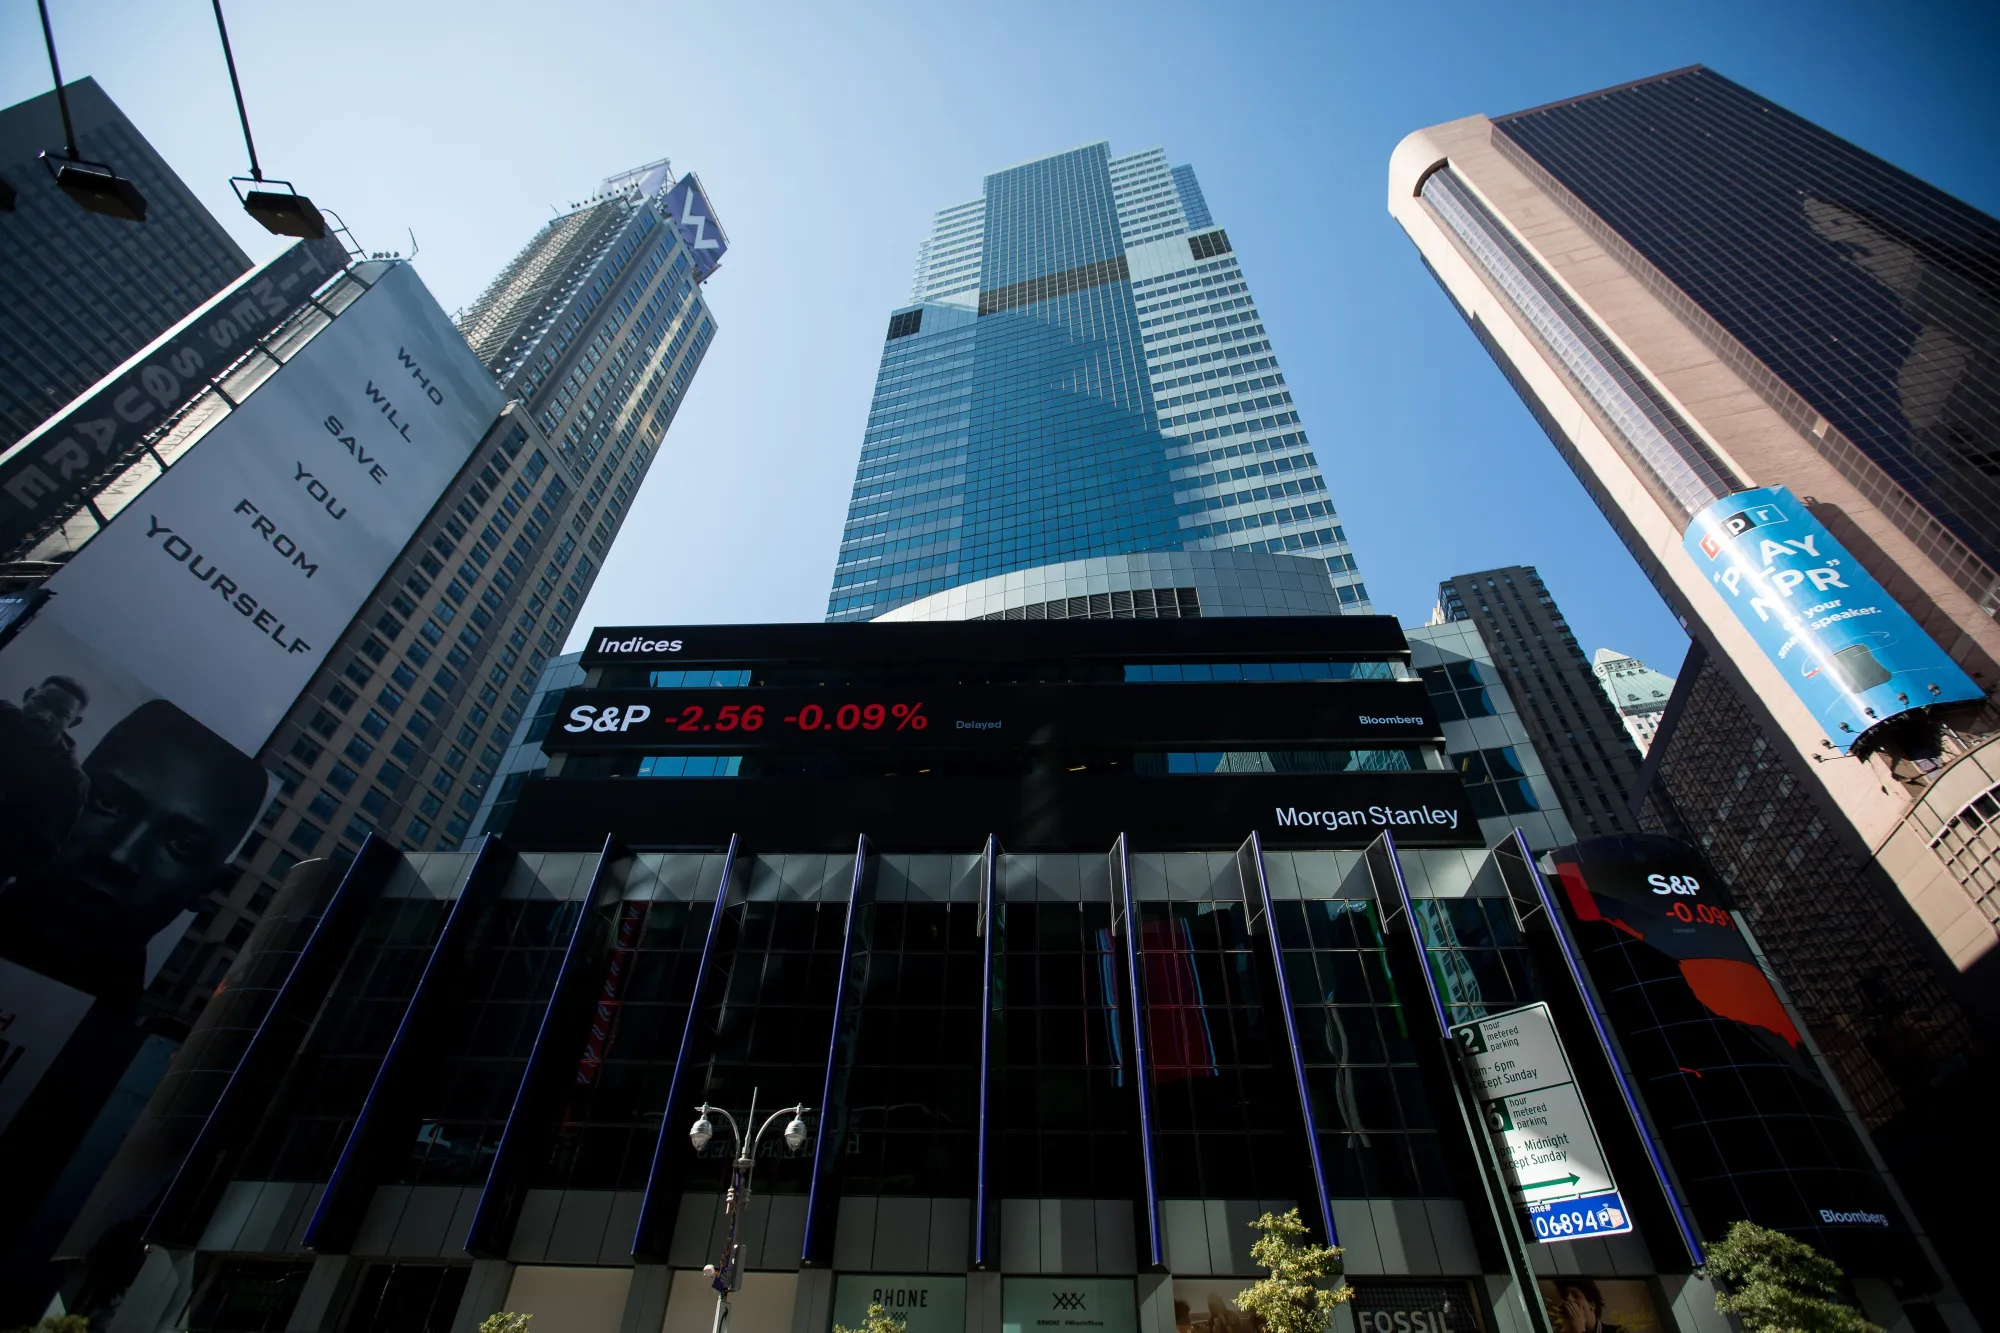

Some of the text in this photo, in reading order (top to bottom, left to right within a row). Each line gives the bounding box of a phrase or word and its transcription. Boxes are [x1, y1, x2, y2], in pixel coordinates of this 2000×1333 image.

[397, 346, 444, 406] WHO
[365, 380, 412, 443] WILL
[323, 415, 388, 485] SAVE
[294, 461, 348, 520] YOU
[233, 498, 319, 579] FROM
[146, 514, 312, 654] YOURSELF
[1803, 599, 1842, 619] your
[1810, 605, 1882, 631] speaker.
[598, 636, 683, 653] Indices
[563, 702, 928, 733] S&P -2.56 -0.09%
[956, 719, 1002, 730] Delayed
[1358, 714, 1424, 726] Bloomberg
[1275, 805, 1458, 831] Morgan Stanley
[1647, 873, 1700, 896] S&P
[1483, 1020, 1500, 1032] hour
[1487, 1025, 1520, 1041] metered
[1459, 1027, 1480, 1054] 2
[1490, 1037, 1519, 1053] parking
[1494, 1060, 1516, 1073] 6pm
[1472, 1068, 1538, 1090] xcept Sunday
[1508, 1096, 1528, 1108] hour
[1512, 1102, 1548, 1118] metered
[1485, 1101, 1505, 1132] 6
[1516, 1115, 1548, 1131] parking
[1523, 1132, 1570, 1152] Midnight
[1500, 1150, 1567, 1171] xcept Sunday
[1819, 1208, 1889, 1227] Bloomberg
[873, 1288, 929, 1308] RHONE
[1357, 1311, 1455, 1333] FOSSIL
